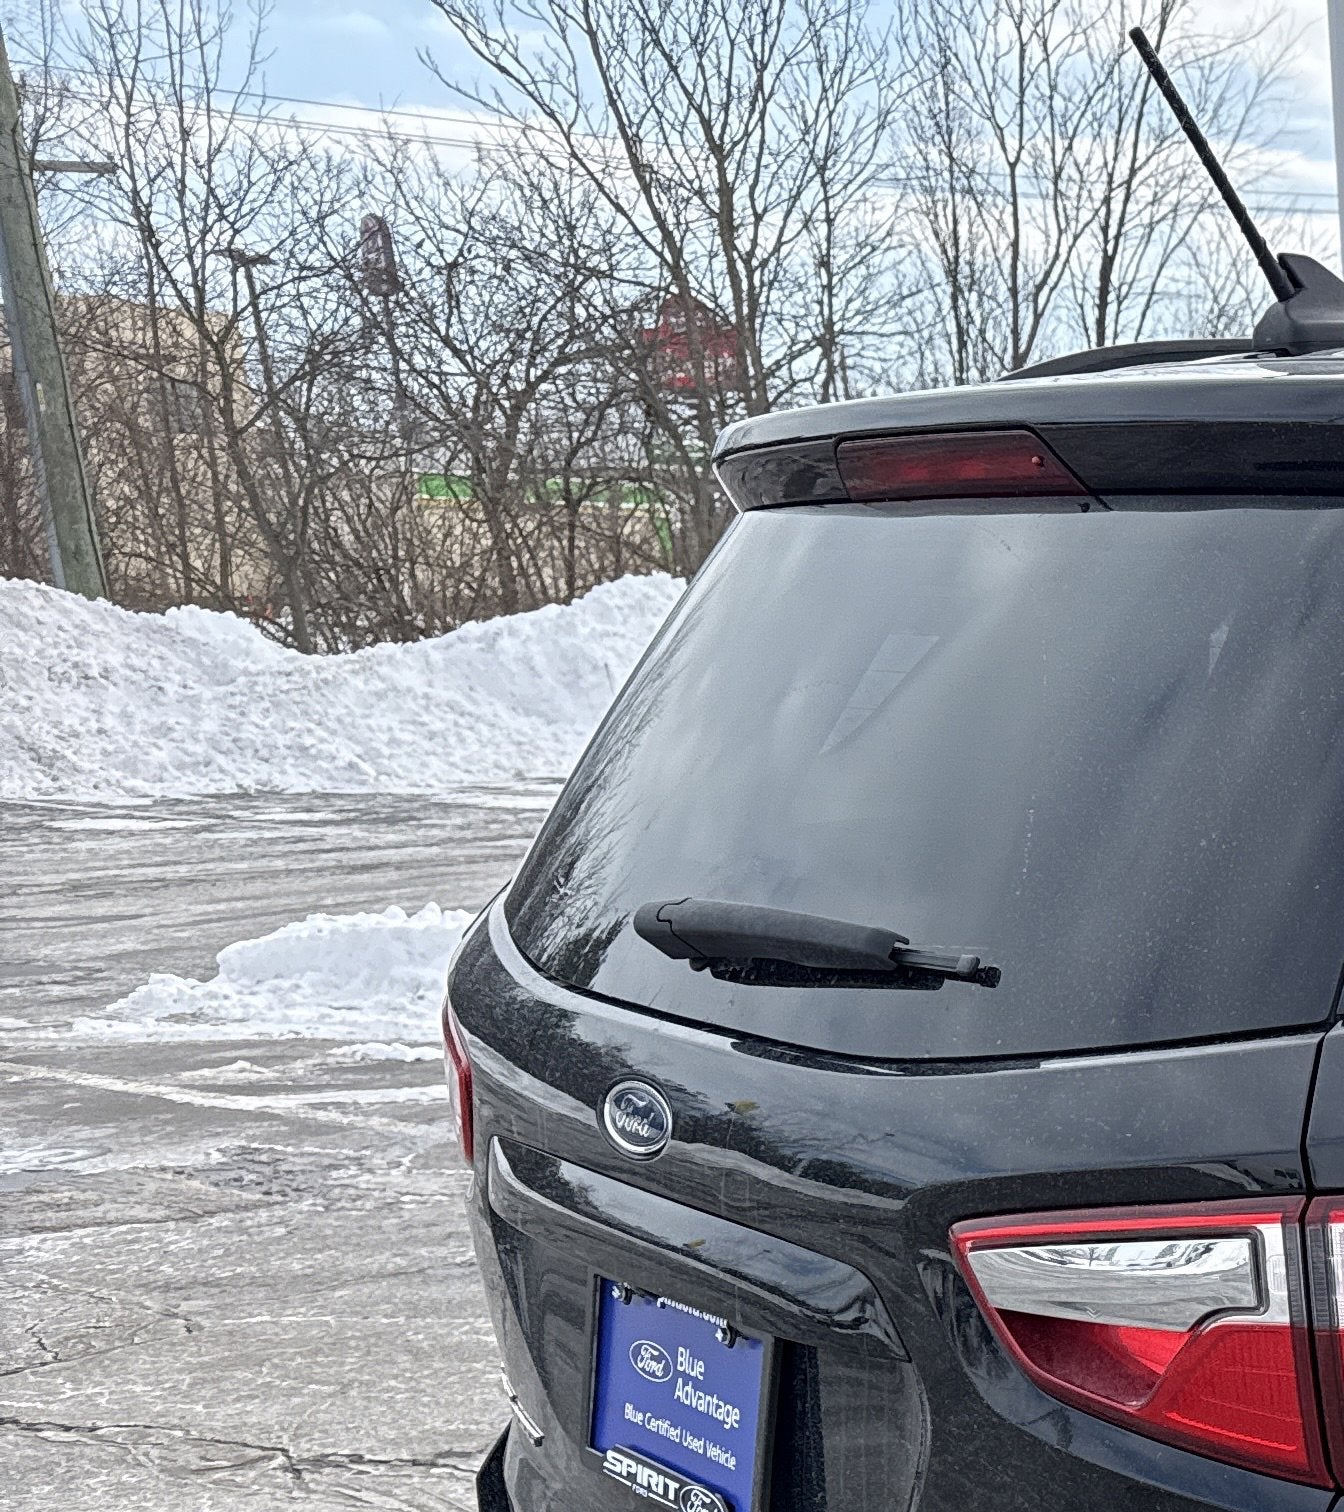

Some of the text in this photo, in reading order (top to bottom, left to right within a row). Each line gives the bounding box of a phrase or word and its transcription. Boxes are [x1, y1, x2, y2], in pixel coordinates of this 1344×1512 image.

[634, 1343, 667, 1378] Ford
[677, 1347, 705, 1380] Blue
[674, 1378, 740, 1429] Advantage
[624, 1402, 737, 1471] Blue Certified Used Vehicle
[602, 1449, 681, 1501] SPIRIT
